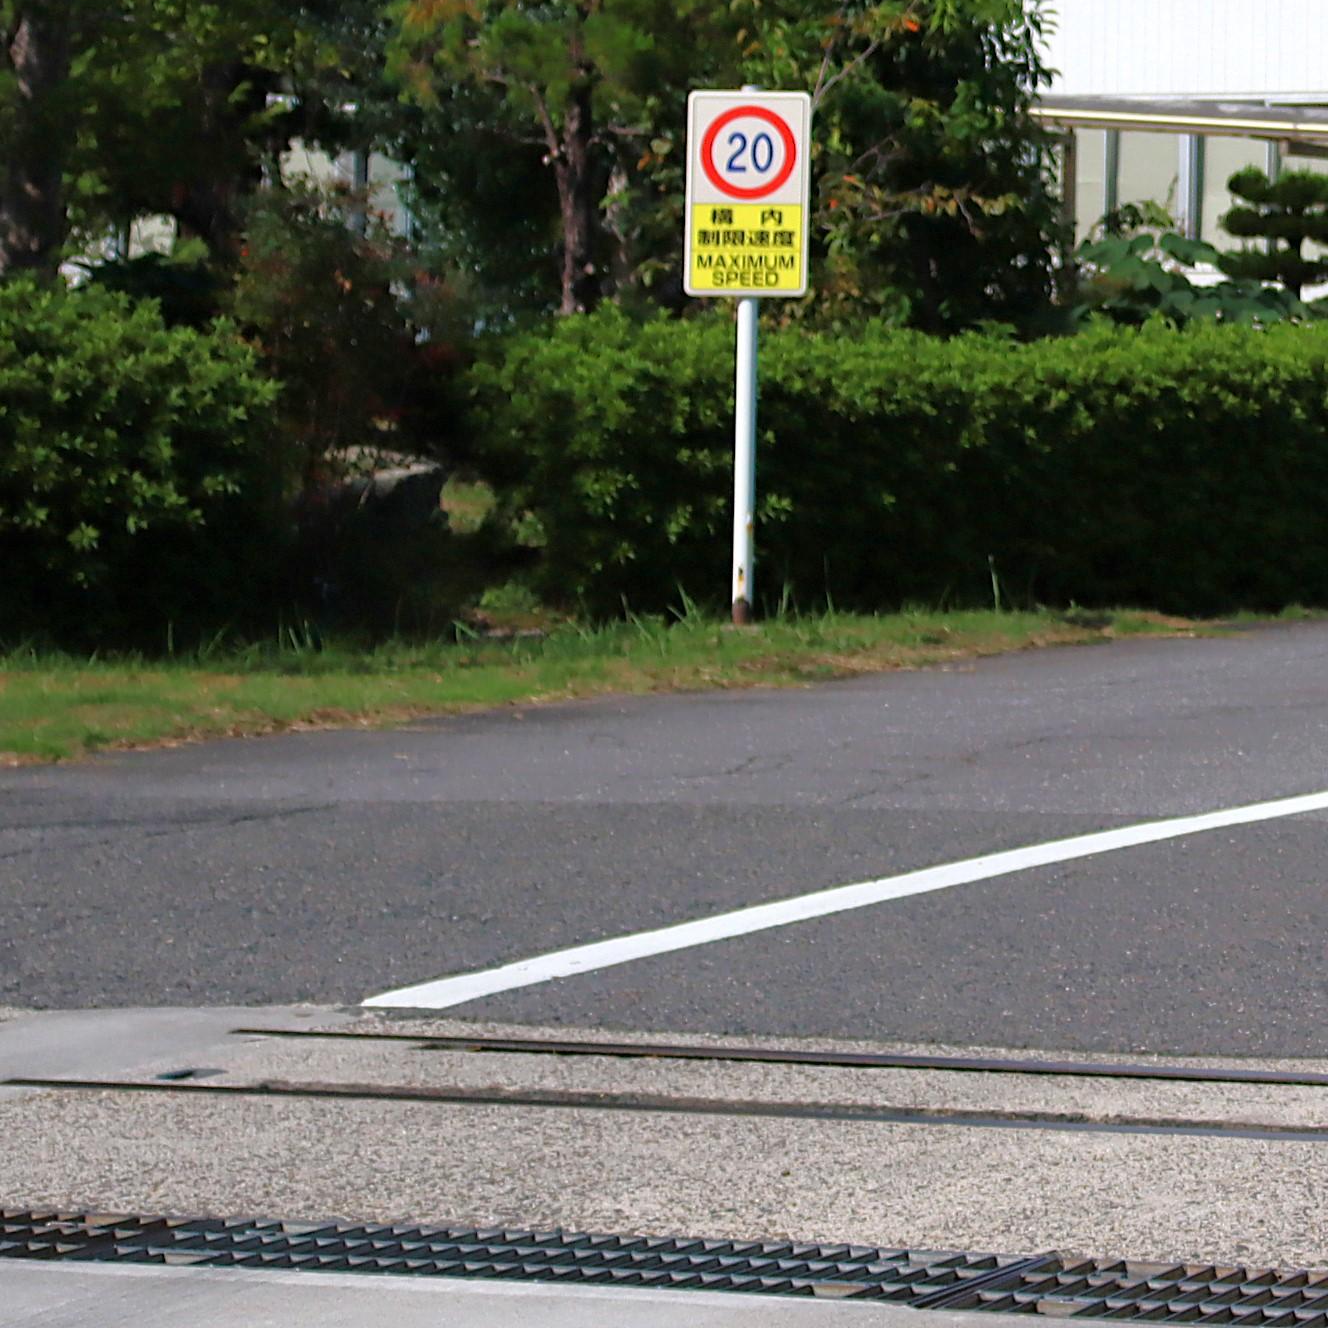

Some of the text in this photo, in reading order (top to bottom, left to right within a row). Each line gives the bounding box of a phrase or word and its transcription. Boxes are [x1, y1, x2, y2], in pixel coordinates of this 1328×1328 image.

[727, 133, 773, 172] 20
[698, 229, 795, 246] 制限速度
[697, 255, 794, 269] MAXIMUM
[712, 271, 779, 286] SPEED
